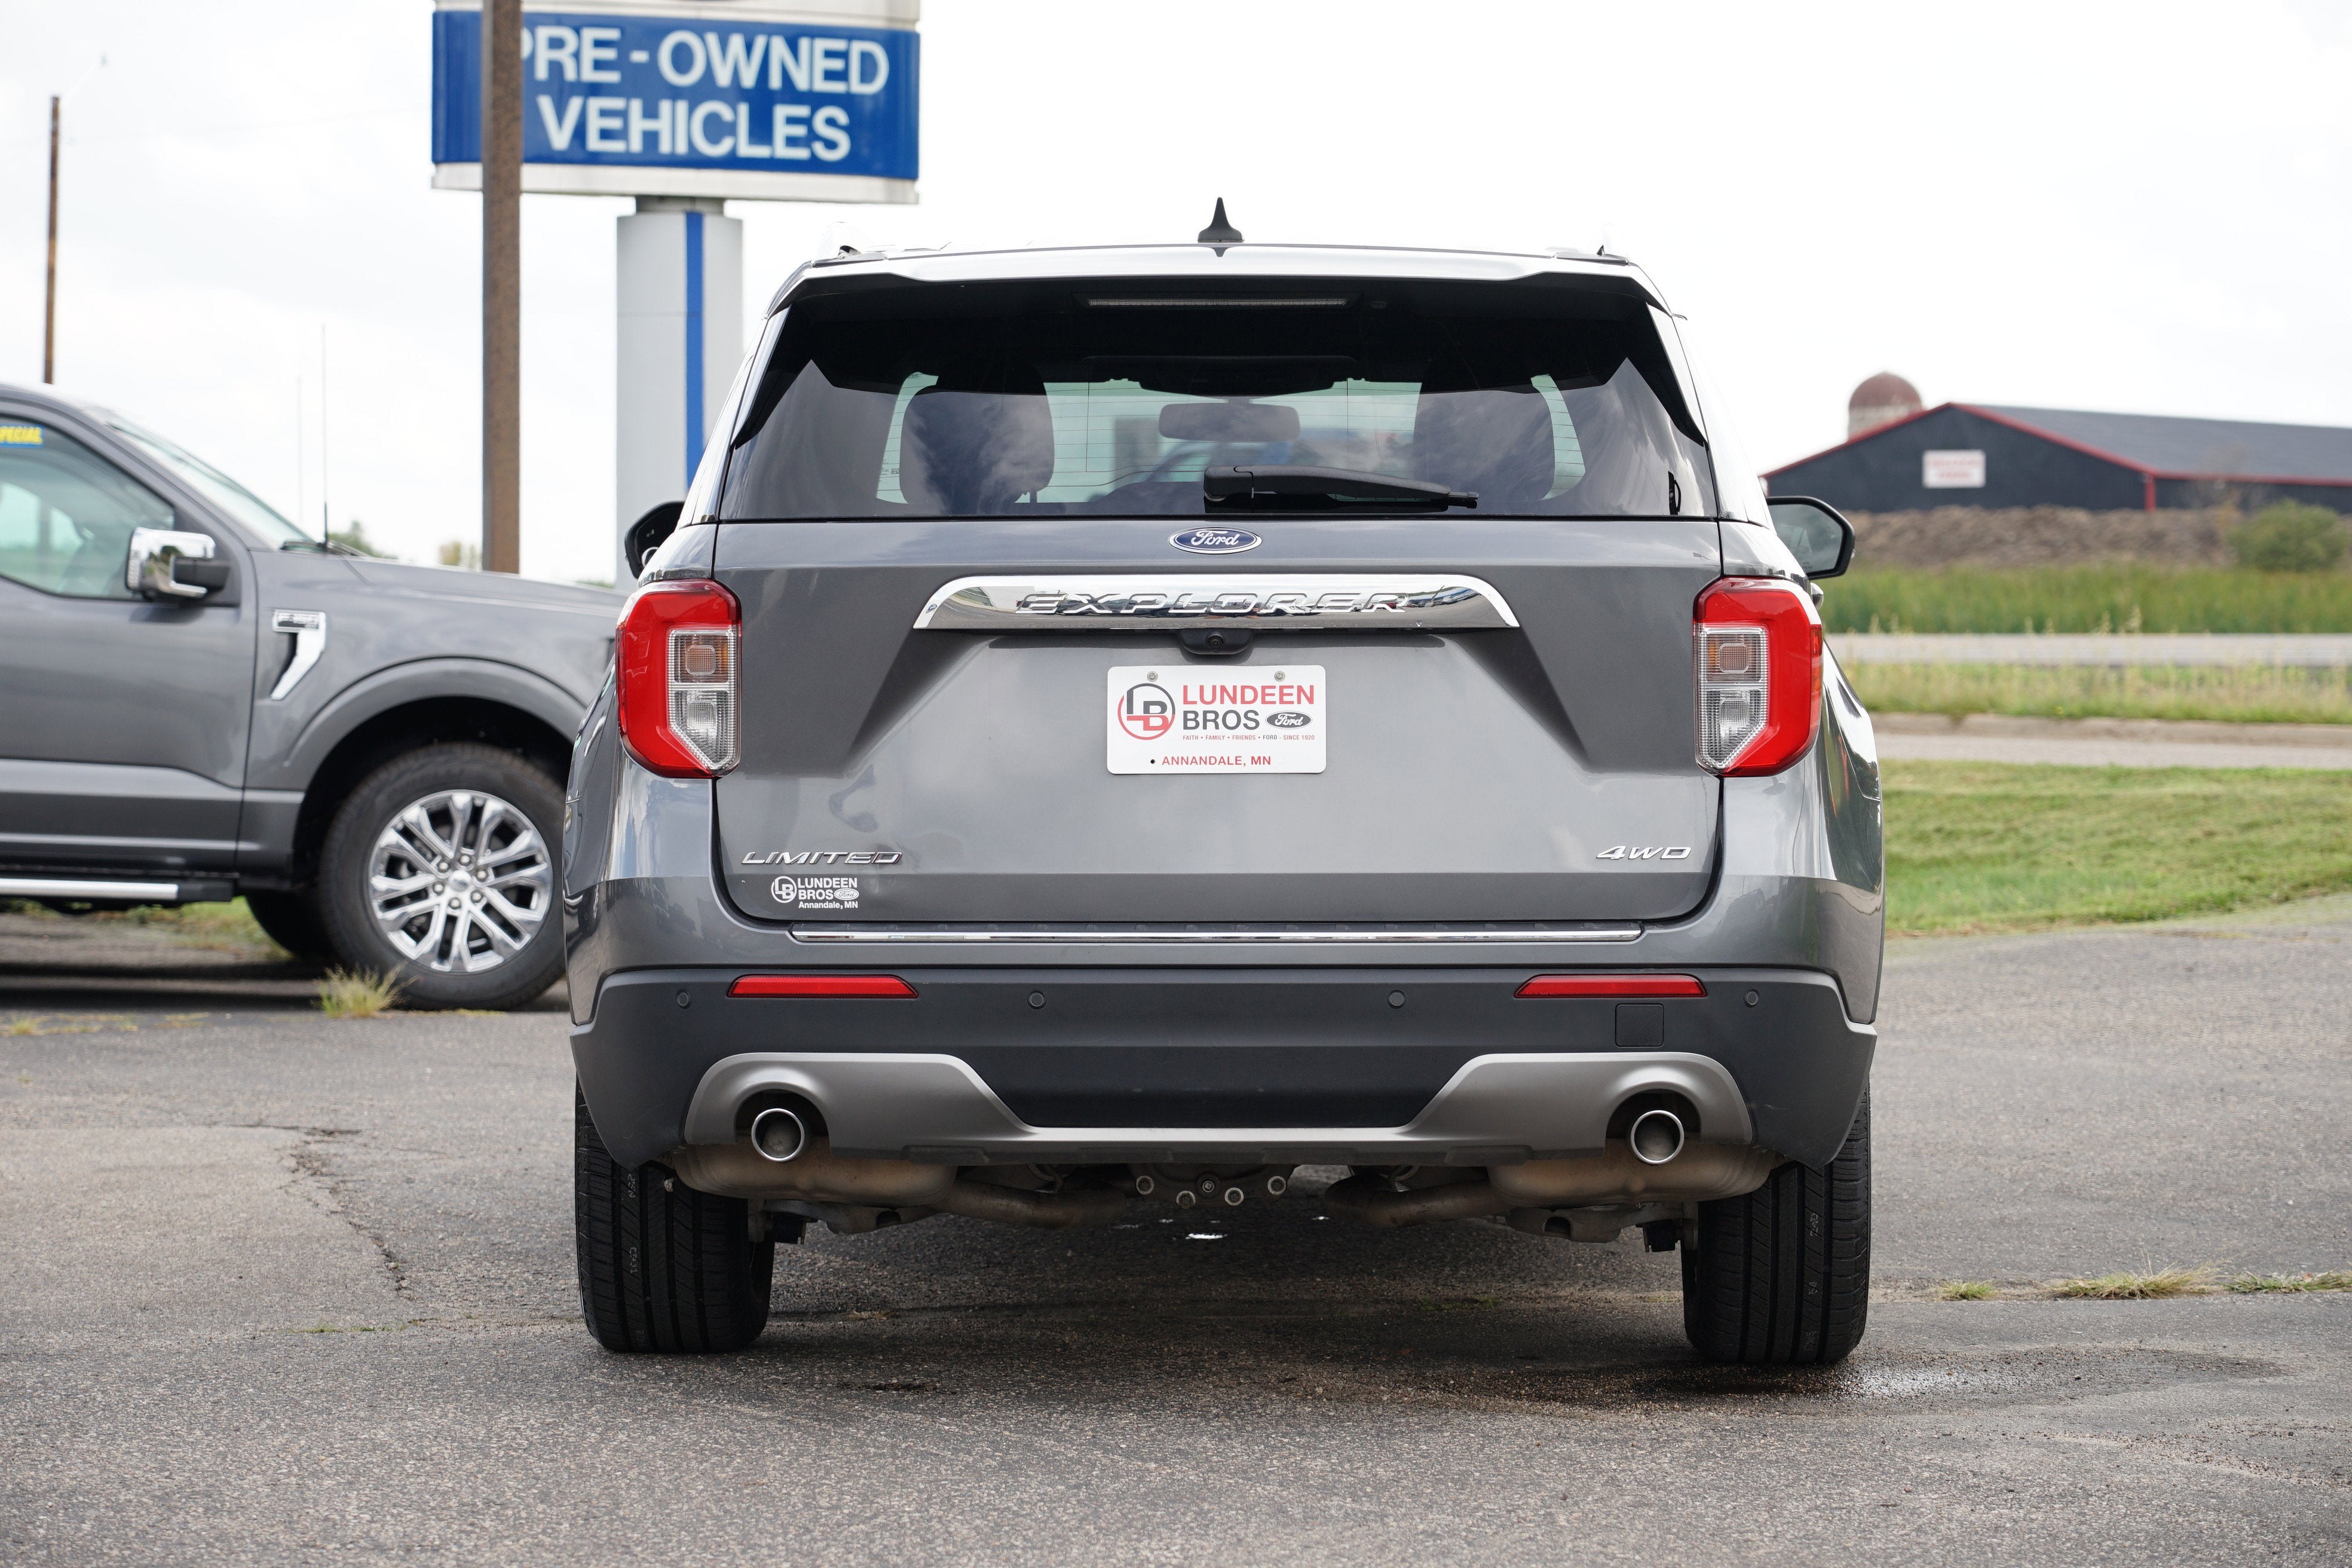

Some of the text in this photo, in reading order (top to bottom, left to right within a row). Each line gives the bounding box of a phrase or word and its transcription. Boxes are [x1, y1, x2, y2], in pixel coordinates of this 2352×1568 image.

[537, 95, 851, 162] VEHICLES
[1190, 530, 1241, 546] Ford
[1016, 592, 1410, 614] EXPLORER
[1183, 684, 1314, 705] LUNDEEN
[1183, 709, 1260, 730] BROS
[1162, 756, 1271, 767] ANNANDALE, MN
[741, 852, 902, 865] LIMITED
[1596, 846, 1692, 860] 4WD
[798, 878, 858, 888] LUNDEEN
[798, 889, 834, 900] BROS
[798, 901, 843, 909] Annandale,
